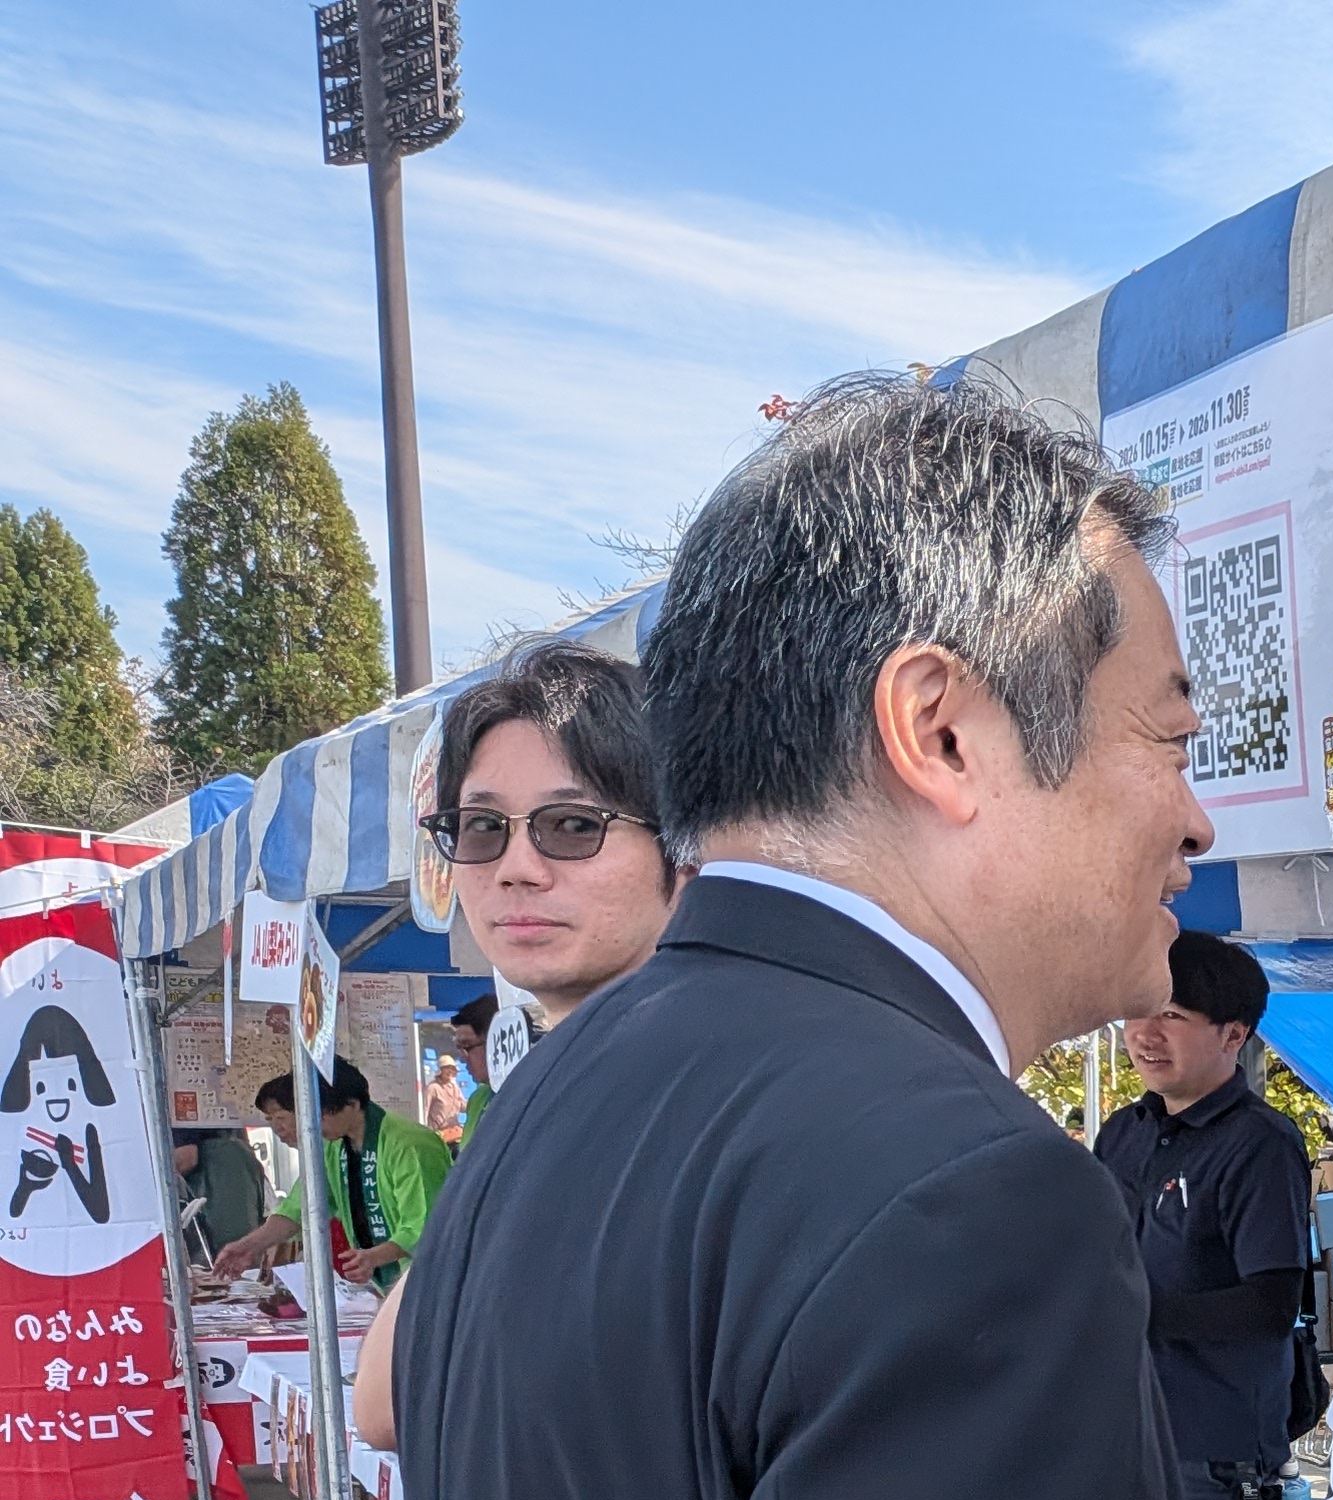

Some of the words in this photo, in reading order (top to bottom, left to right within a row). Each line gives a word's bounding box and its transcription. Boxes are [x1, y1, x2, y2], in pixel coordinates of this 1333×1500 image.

[1188, 411, 1210, 440] 2026
[1210, 389, 1243, 430] 11.30
[1140, 421, 1169, 461] 10.15
